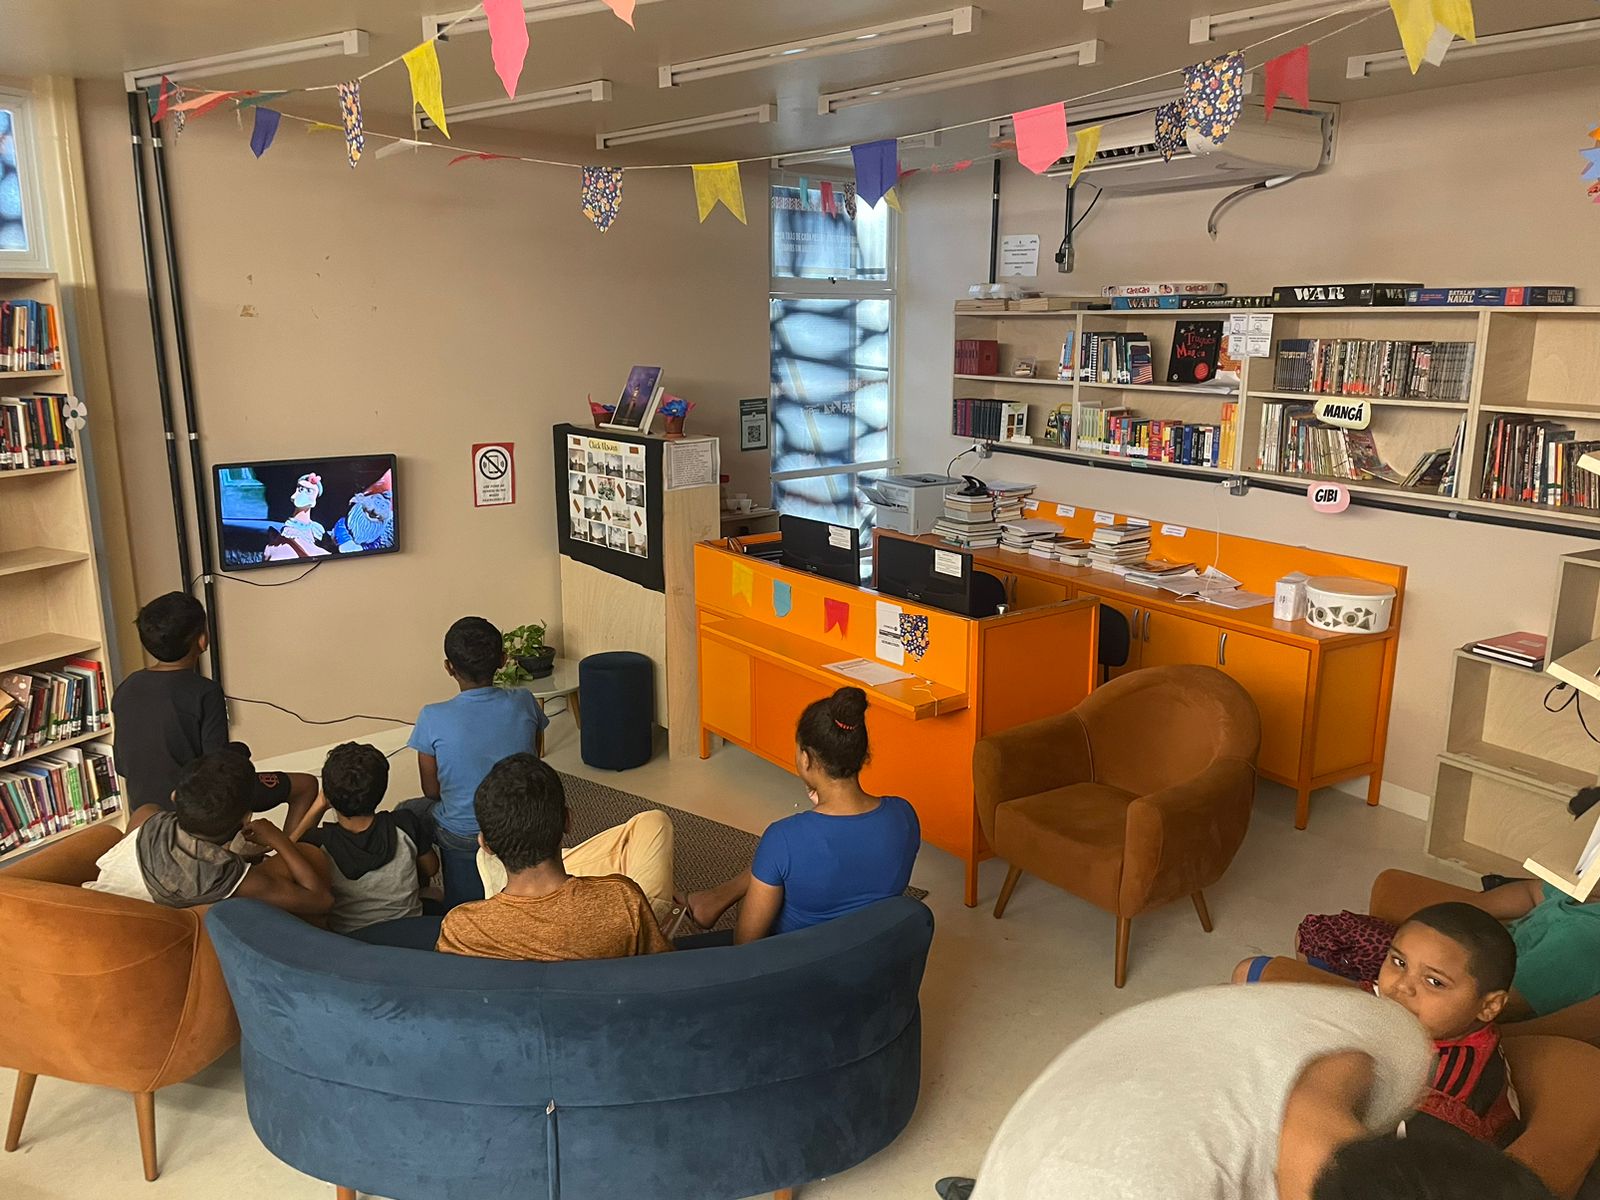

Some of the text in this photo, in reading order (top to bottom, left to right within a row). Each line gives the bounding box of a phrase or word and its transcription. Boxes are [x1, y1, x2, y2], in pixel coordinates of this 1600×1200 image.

[1293, 286, 1346, 301] WAR
[1385, 288, 1407, 299] WA
[1447, 295, 1475, 304] NAVAL
[1127, 298, 1159, 309] WAR
[1323, 403, 1364, 421] MANGÁ
[1315, 489, 1338, 502] GIBI
